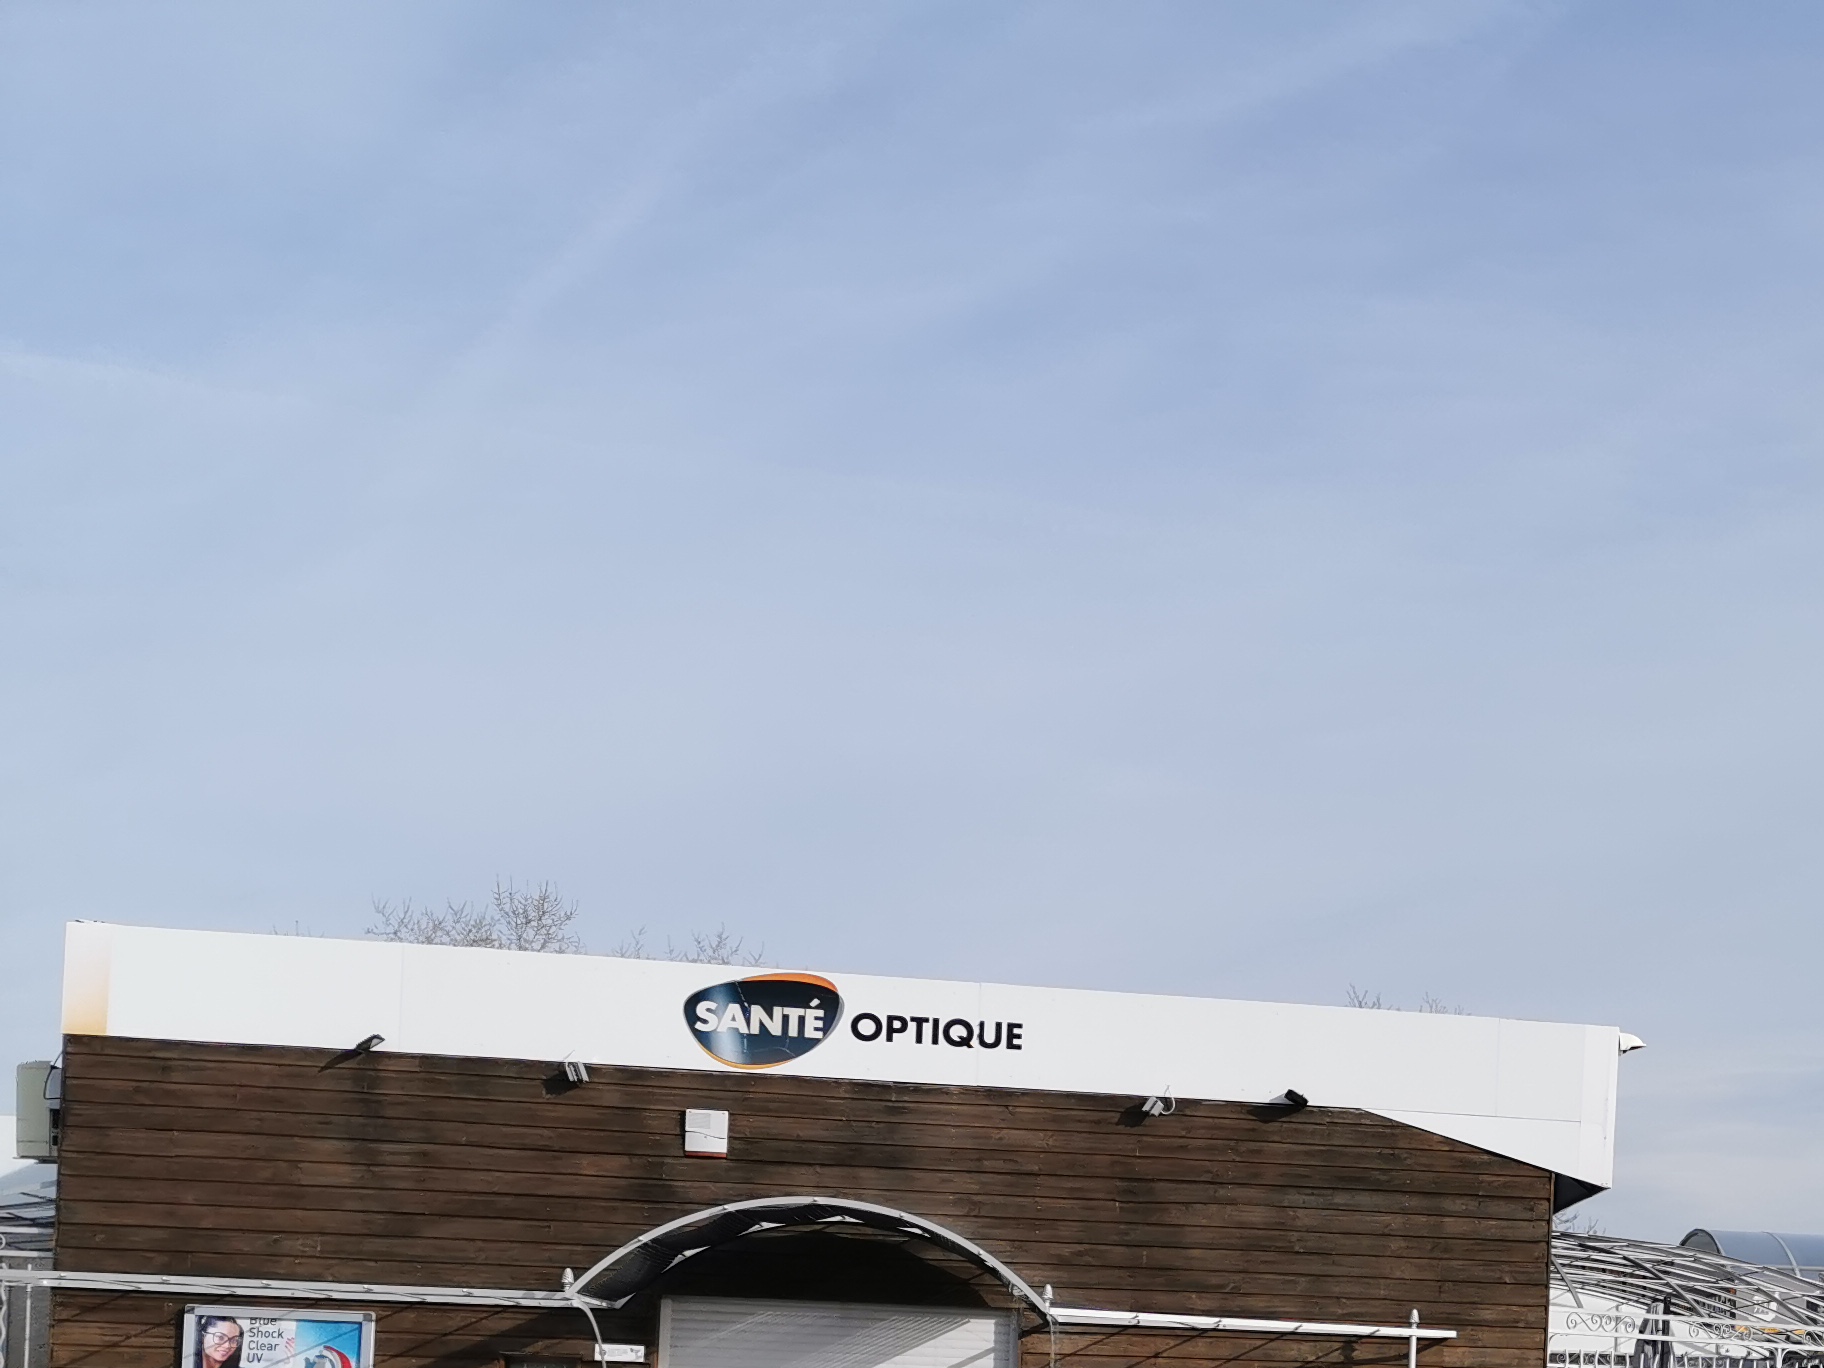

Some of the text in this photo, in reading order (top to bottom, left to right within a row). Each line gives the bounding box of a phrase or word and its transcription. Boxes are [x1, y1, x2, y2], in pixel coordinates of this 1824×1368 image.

[694, 998, 1023, 1050] SANTÉ OPTIQUE
[248, 1327, 284, 1339] Shock
[248, 1340, 280, 1351] Clear
[246, 1352, 264, 1364] UV
